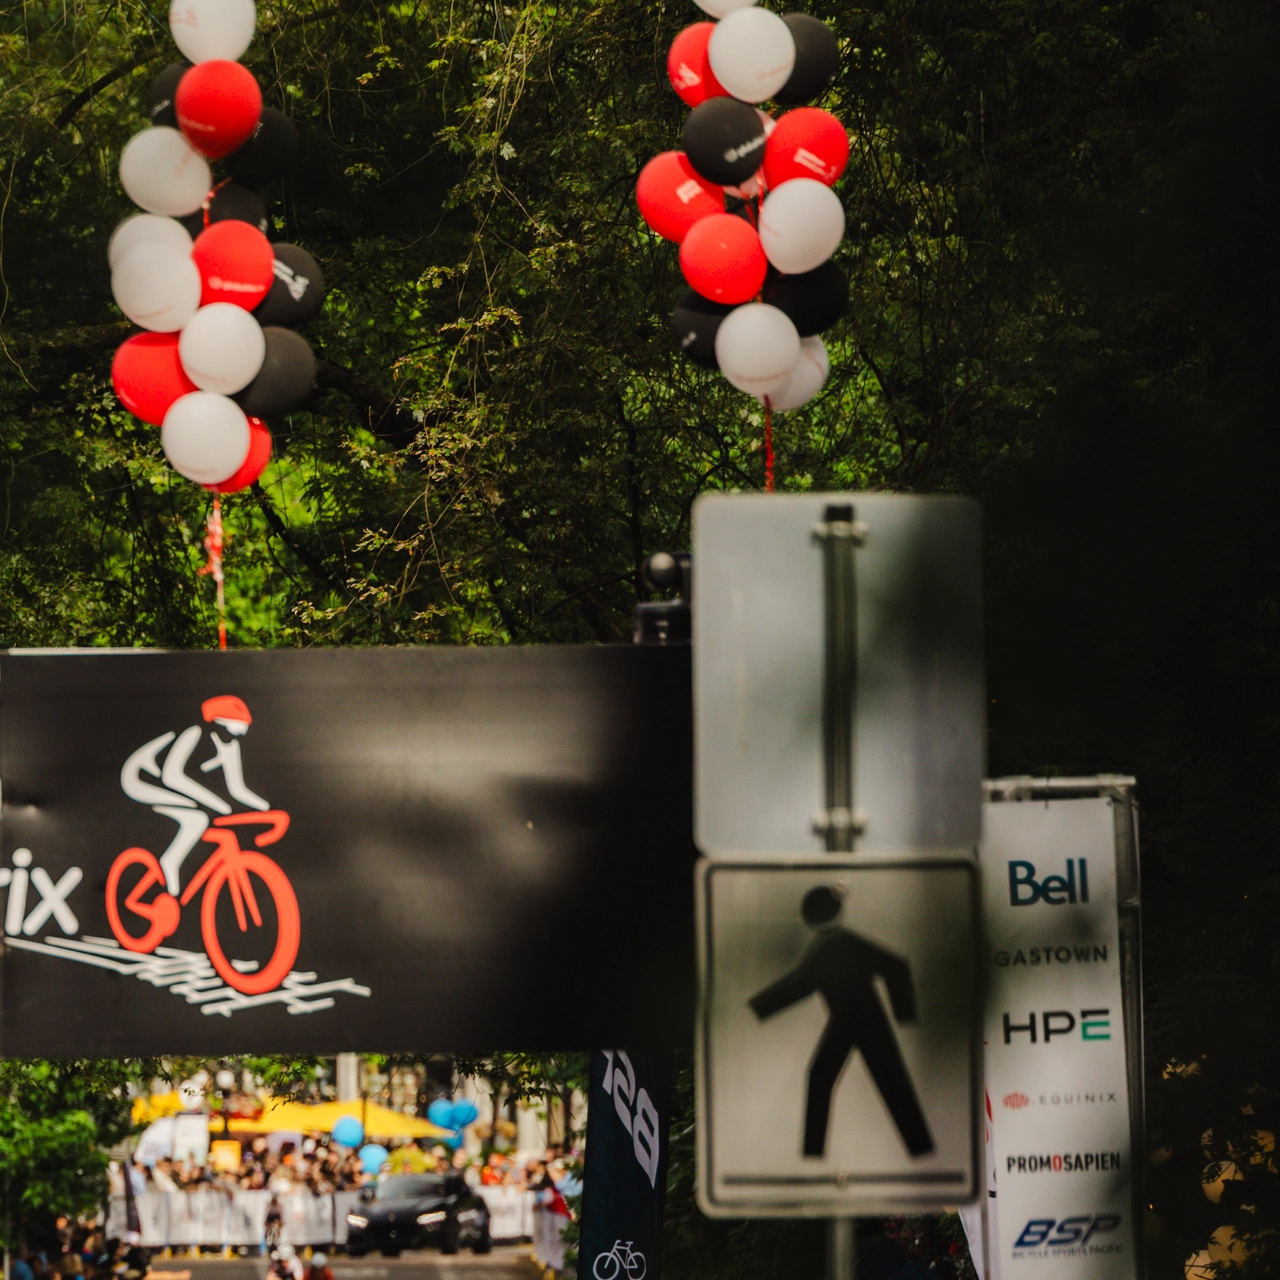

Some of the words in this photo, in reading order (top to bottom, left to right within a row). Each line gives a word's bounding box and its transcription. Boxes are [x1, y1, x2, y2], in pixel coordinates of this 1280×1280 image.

[1007, 857, 1090, 907] Bell
[994, 944, 1108, 968] GASTOWN
[1002, 1009, 1112, 1045] HPE
[1038, 1091, 1118, 1106] EQUINIX
[1007, 1151, 1121, 1174] PROMOSAPIEN
[1013, 1212, 1123, 1247] BSP
